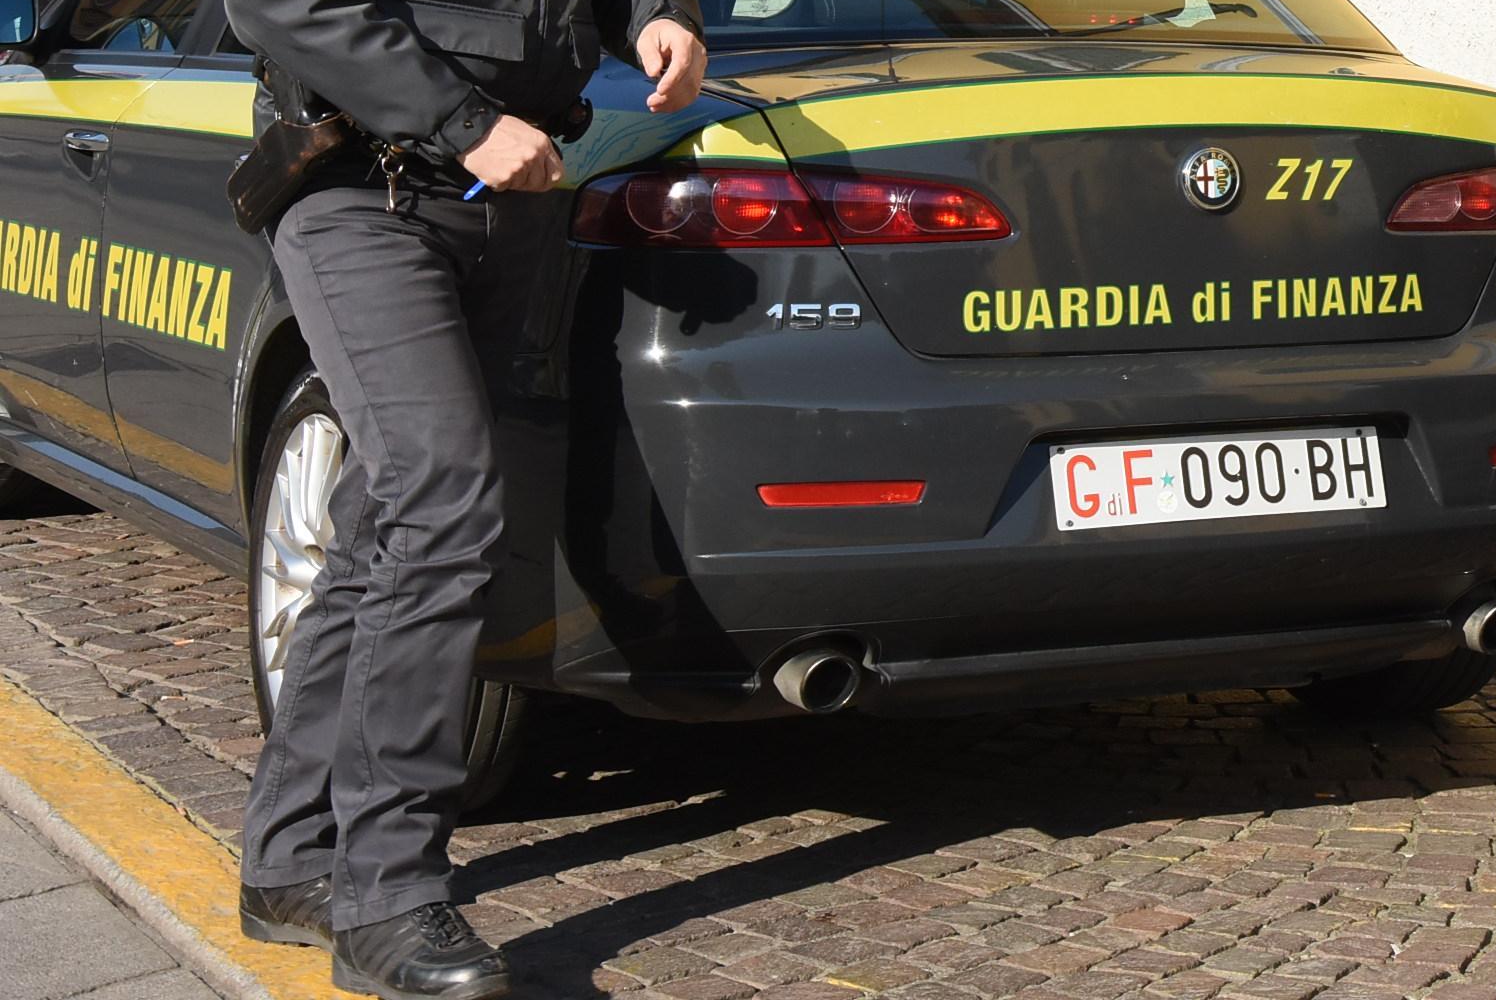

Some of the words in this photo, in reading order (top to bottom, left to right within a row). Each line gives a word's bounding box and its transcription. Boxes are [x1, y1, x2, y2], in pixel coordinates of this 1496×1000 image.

[1265, 158, 1353, 201] Z17
[0, 219, 60, 303] RDIA
[67, 237, 97, 313] di
[101, 242, 233, 351] FINANZA
[962, 284, 1173, 333] GUARDIA
[1191, 281, 1231, 324] di
[1252, 273, 1424, 320] FINANZA
[765, 303, 861, 331] 159
